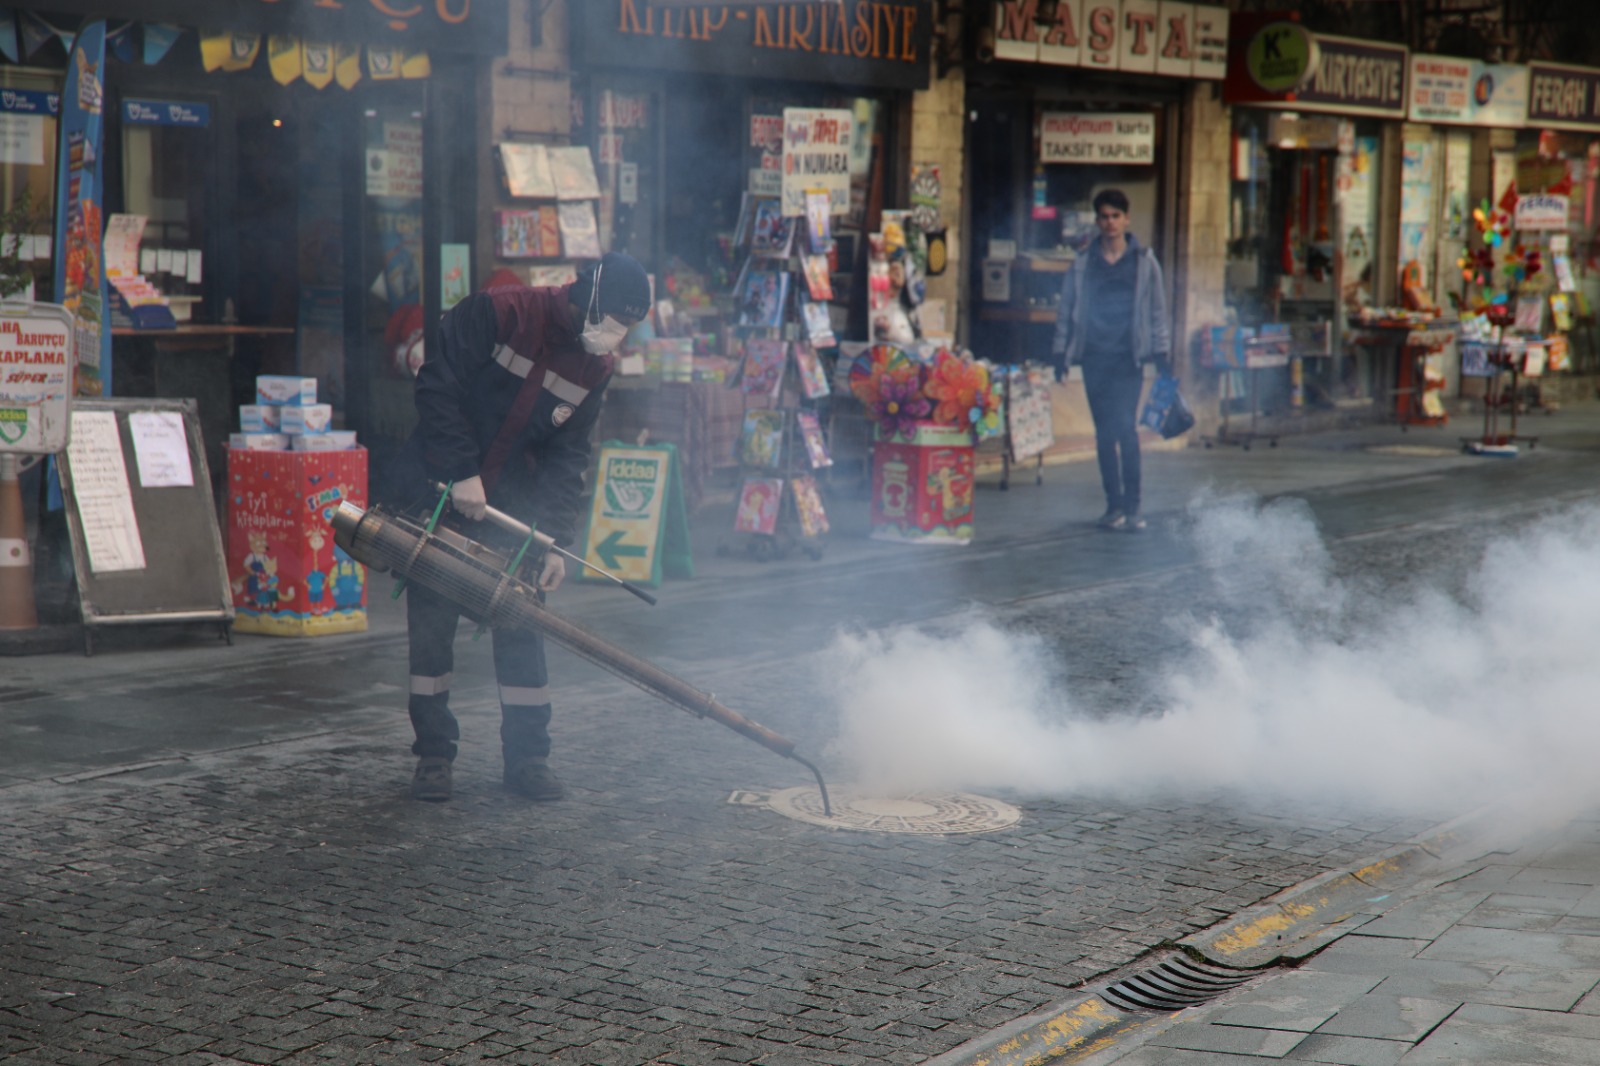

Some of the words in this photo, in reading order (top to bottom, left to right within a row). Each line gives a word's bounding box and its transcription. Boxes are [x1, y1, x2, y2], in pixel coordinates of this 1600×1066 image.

[1531, 75, 1588, 118] FERAH
[1045, 139, 1095, 158] TAKSİT
[1098, 143, 1151, 159] YAPILIR
[803, 153, 848, 174] NUMARA
[17, 333, 65, 349] BARUTÇU
[6, 370, 48, 384] SÜPER
[609, 459, 656, 480] iddaa
[236, 511, 295, 529] kitaplarım
